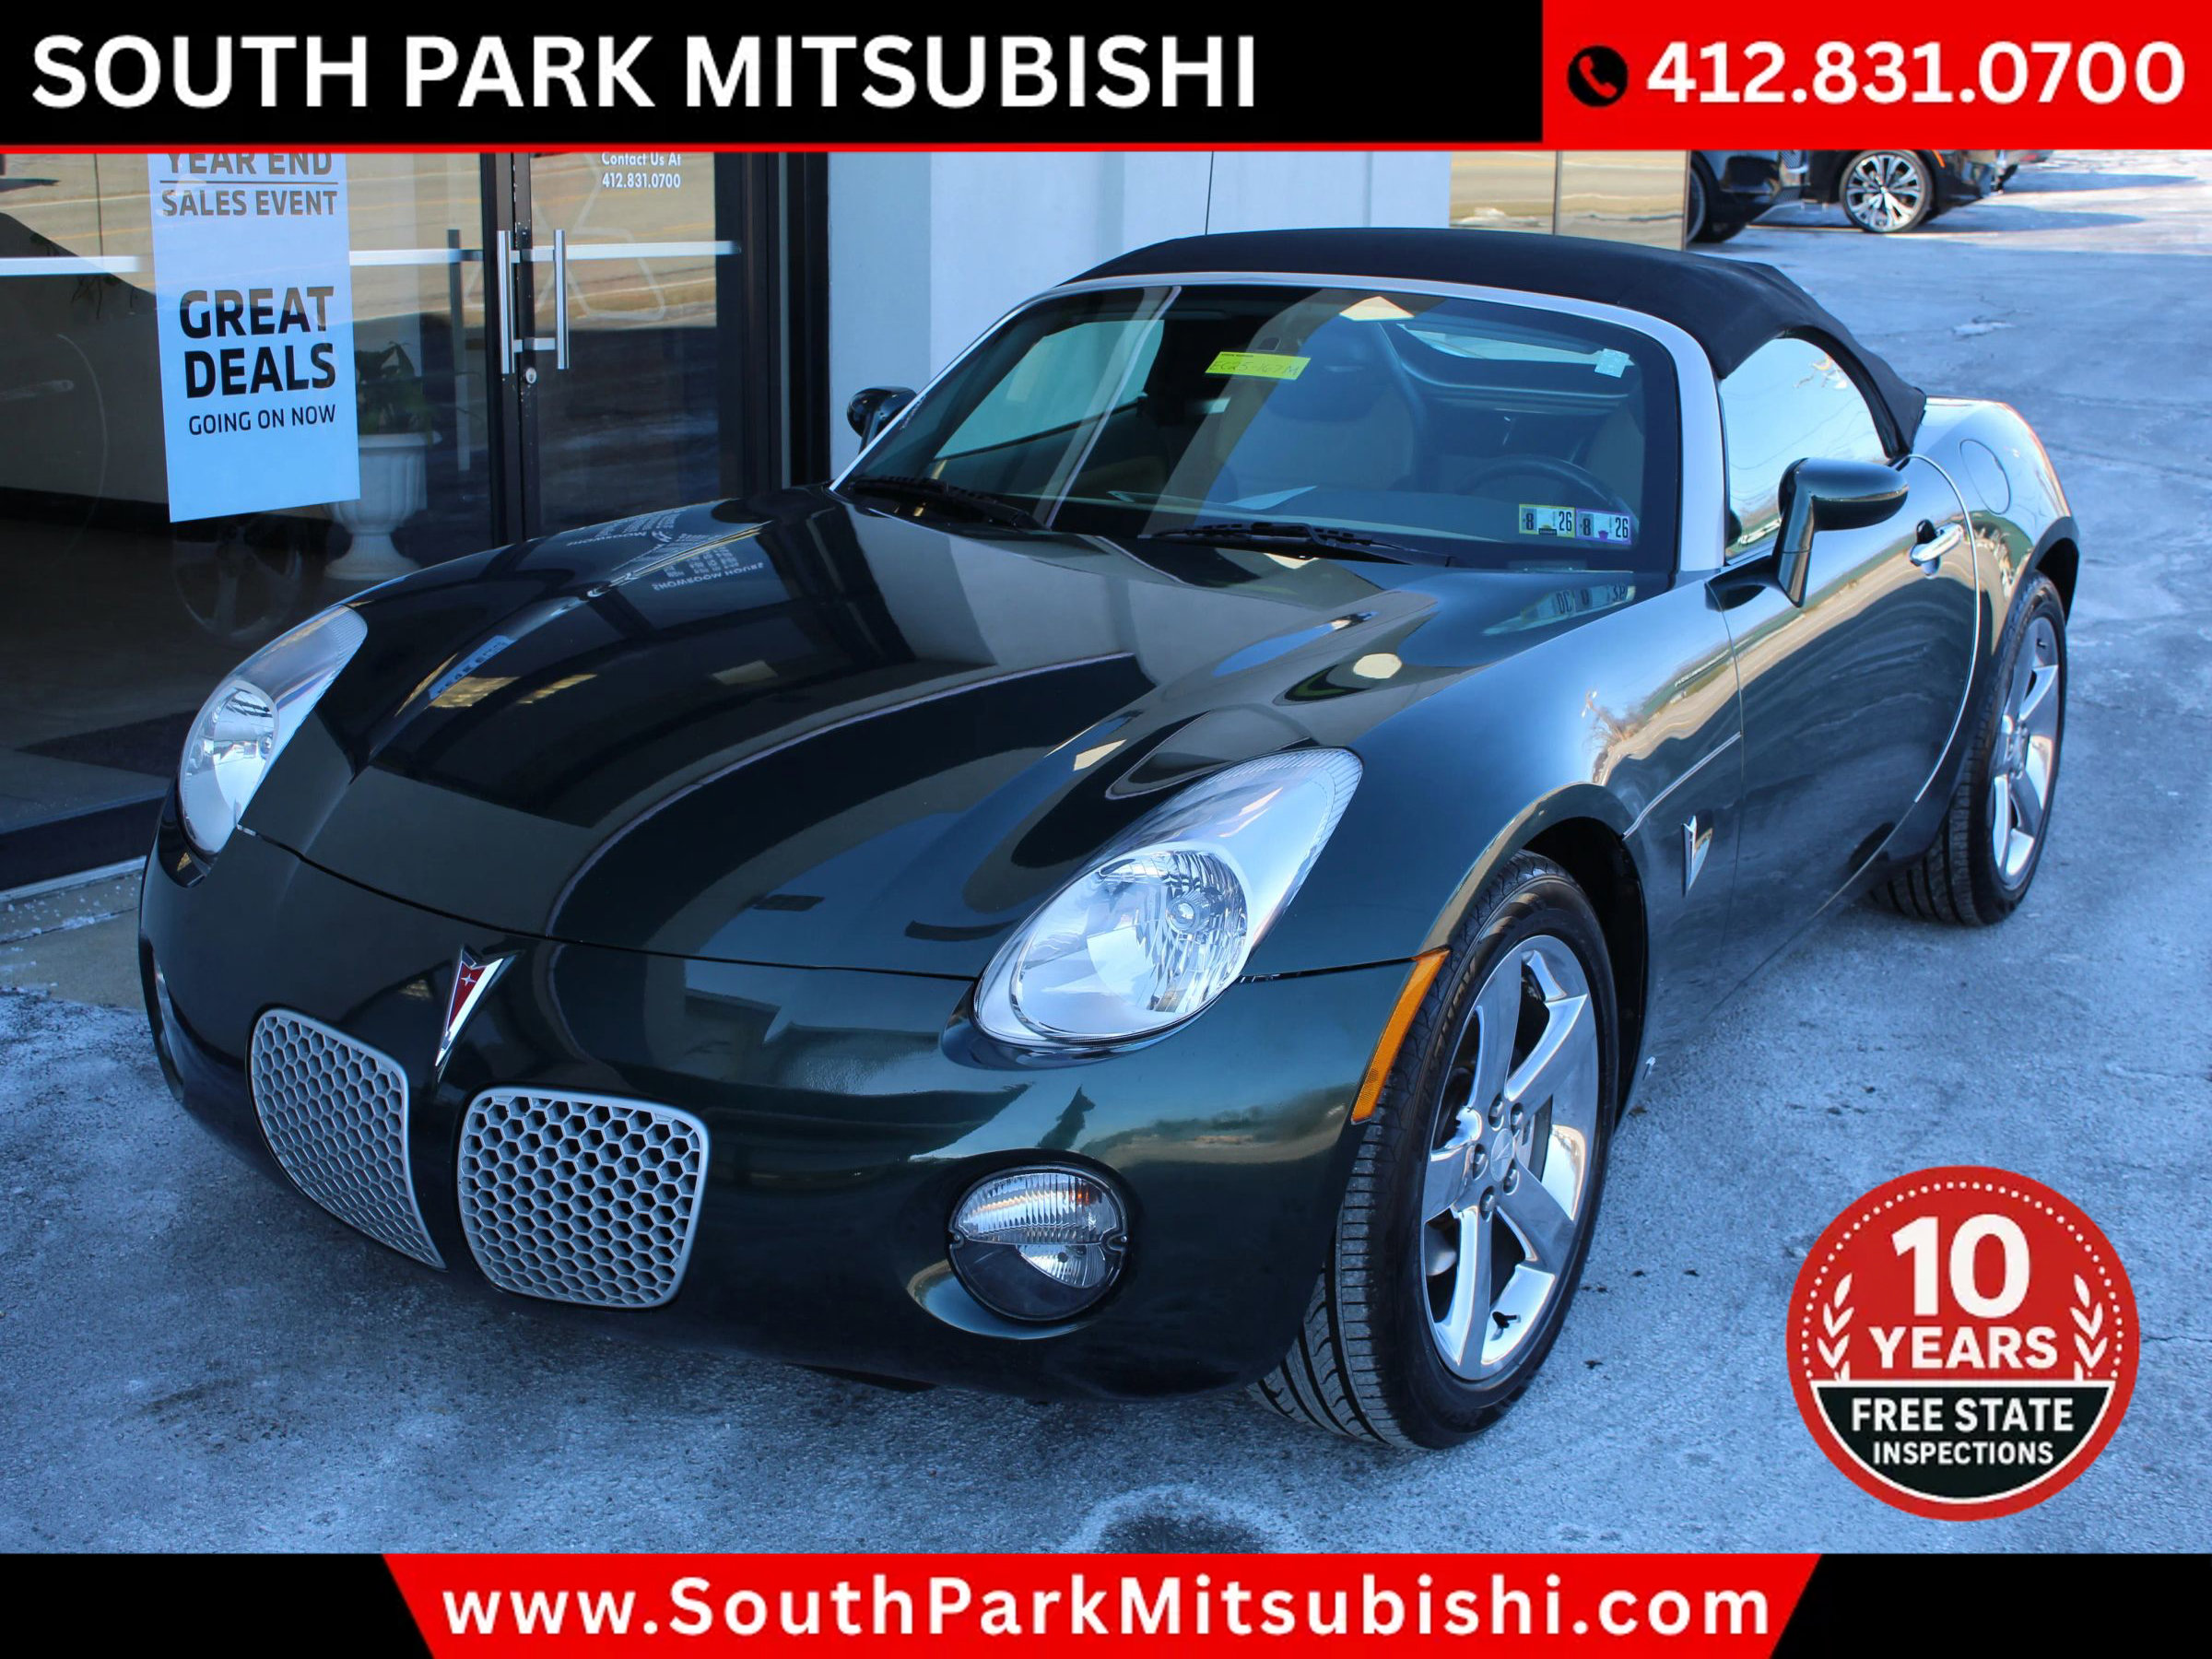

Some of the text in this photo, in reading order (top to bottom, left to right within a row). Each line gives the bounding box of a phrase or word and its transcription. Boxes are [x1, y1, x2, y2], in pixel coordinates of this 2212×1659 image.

[167, 152, 333, 175] YEAR END
[601, 152, 681, 166] Contact Us At
[602, 171, 681, 189] 412.831.0700
[161, 190, 337, 217] SALES EVENT
[179, 286, 335, 339] GREAT
[184, 342, 336, 399] DEALS
[188, 404, 336, 436] GOING ON NOW
[1525, 510, 1572, 532] 8 26
[1583, 516, 1629, 538] 8 26
